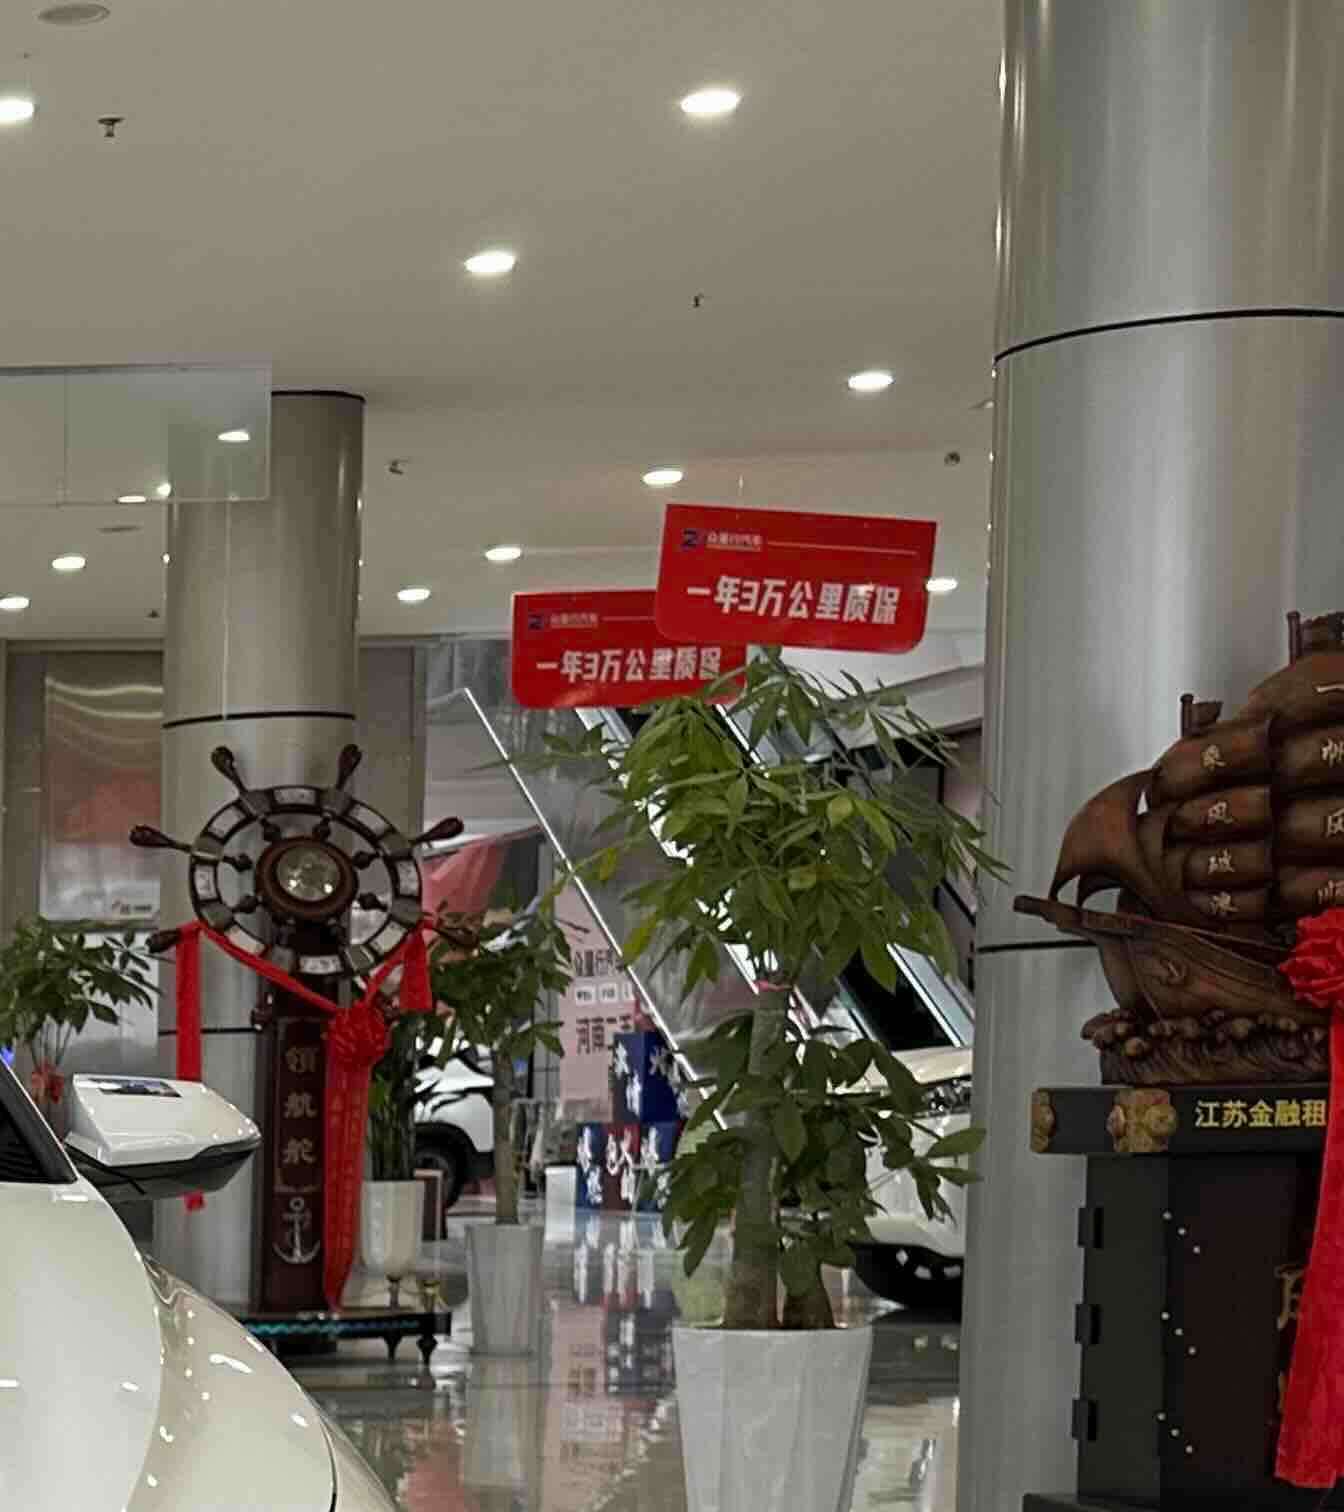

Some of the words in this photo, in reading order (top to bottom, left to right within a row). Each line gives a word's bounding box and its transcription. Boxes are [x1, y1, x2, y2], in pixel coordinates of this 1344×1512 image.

[686, 574, 901, 625] 一年3万公里质保
[1194, 1099, 1327, 1129] 江苏金融租
